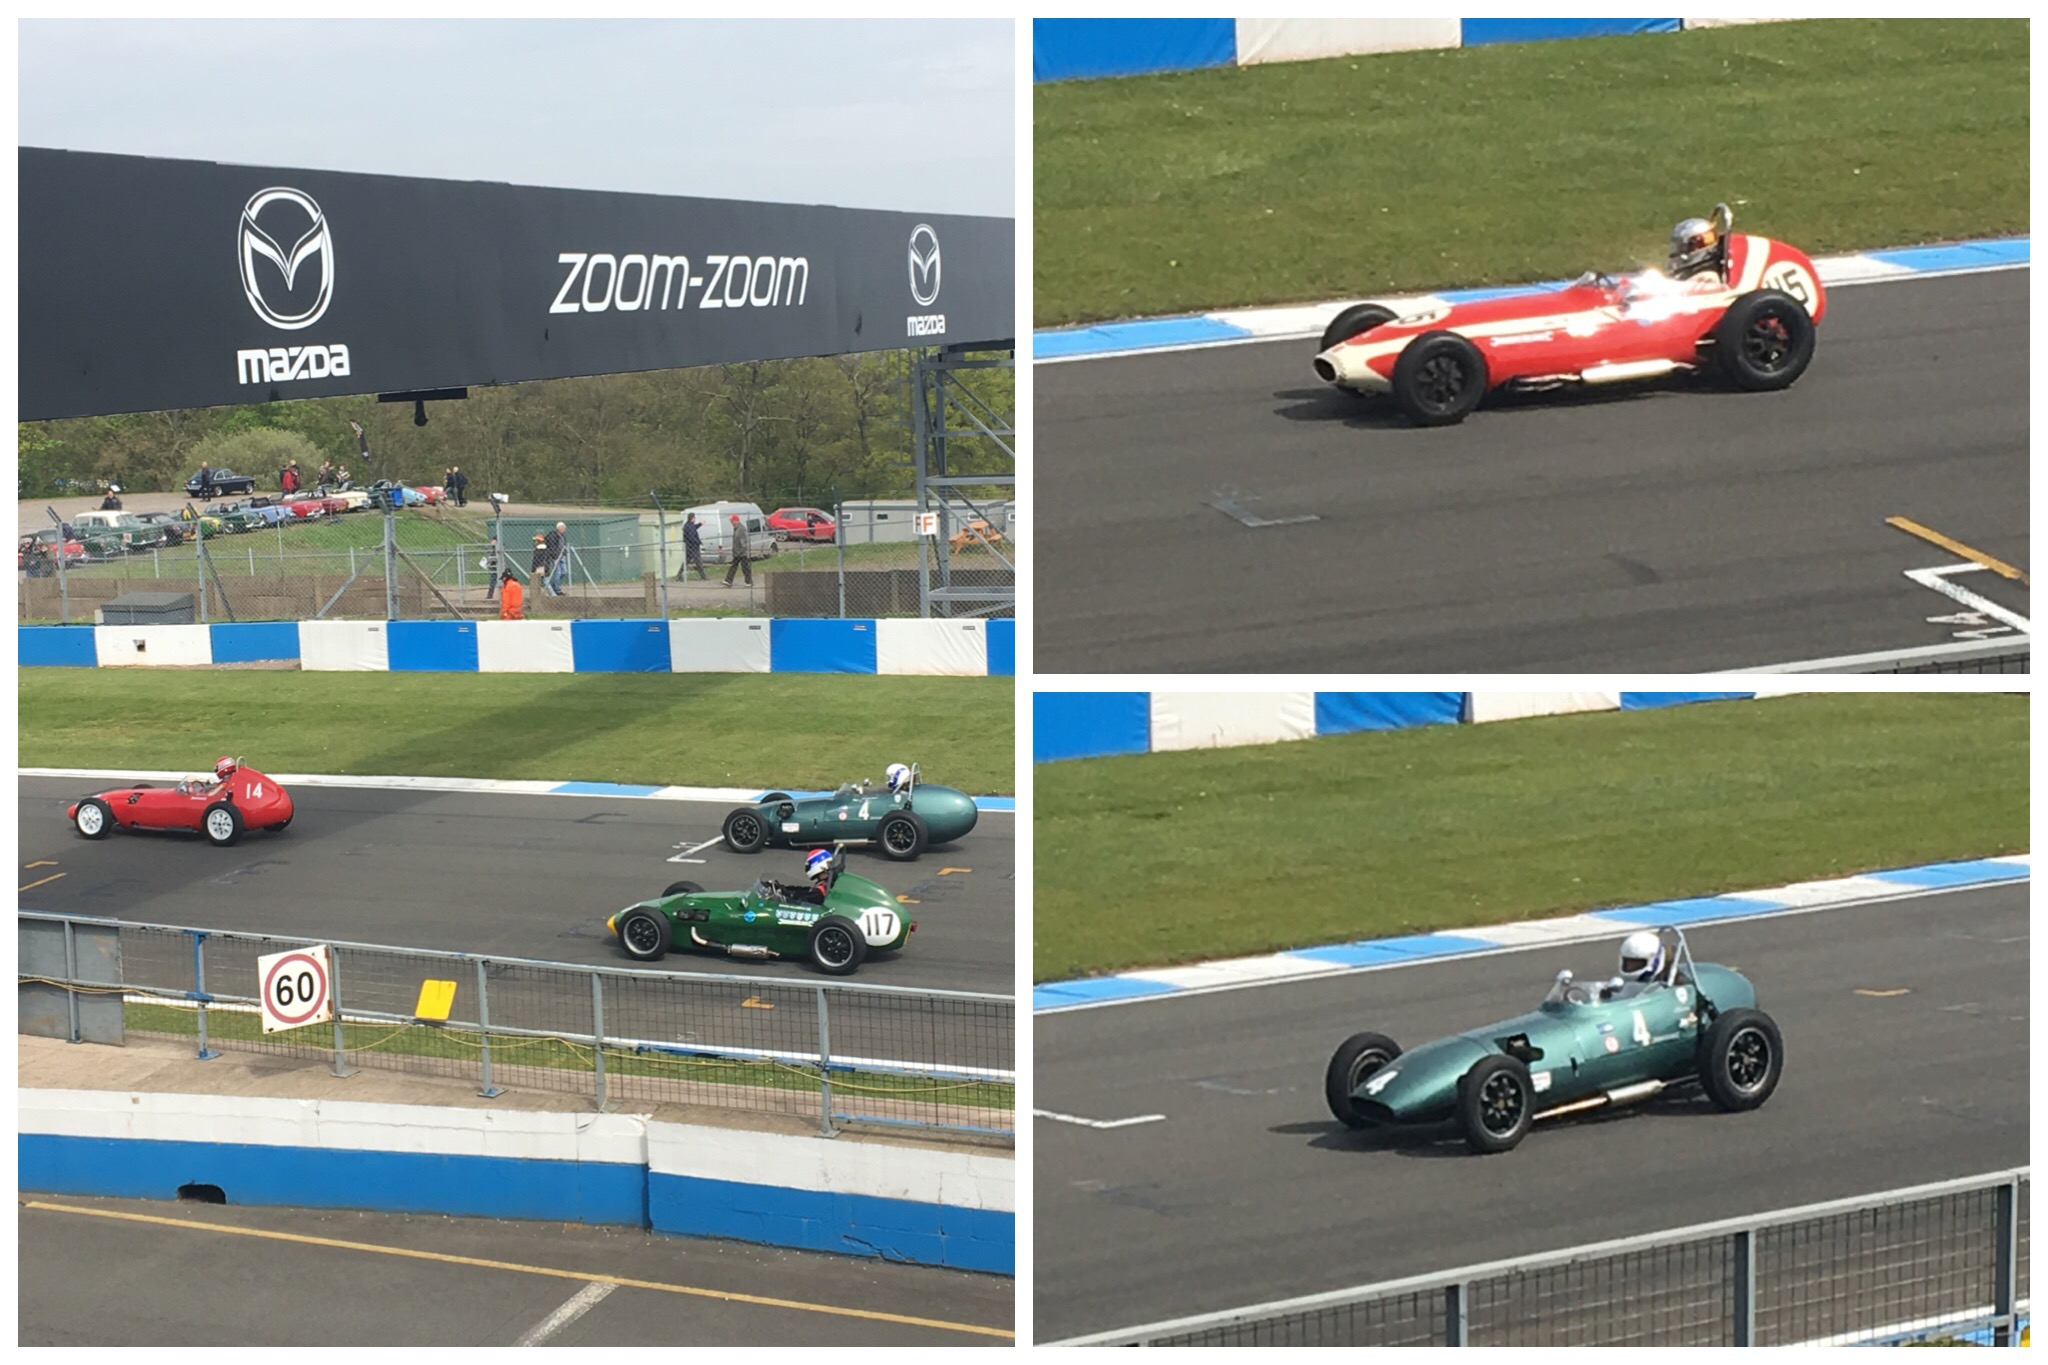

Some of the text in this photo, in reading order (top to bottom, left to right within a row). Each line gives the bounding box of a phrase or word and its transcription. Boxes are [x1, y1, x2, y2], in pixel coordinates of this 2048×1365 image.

[246, 783, 263, 799] 14
[858, 799, 870, 820] 4
[866, 913, 894, 936] 117
[276, 971, 314, 1006] 60
[1632, 1009, 1651, 1047] 4
[1365, 1070, 1399, 1095] 4
